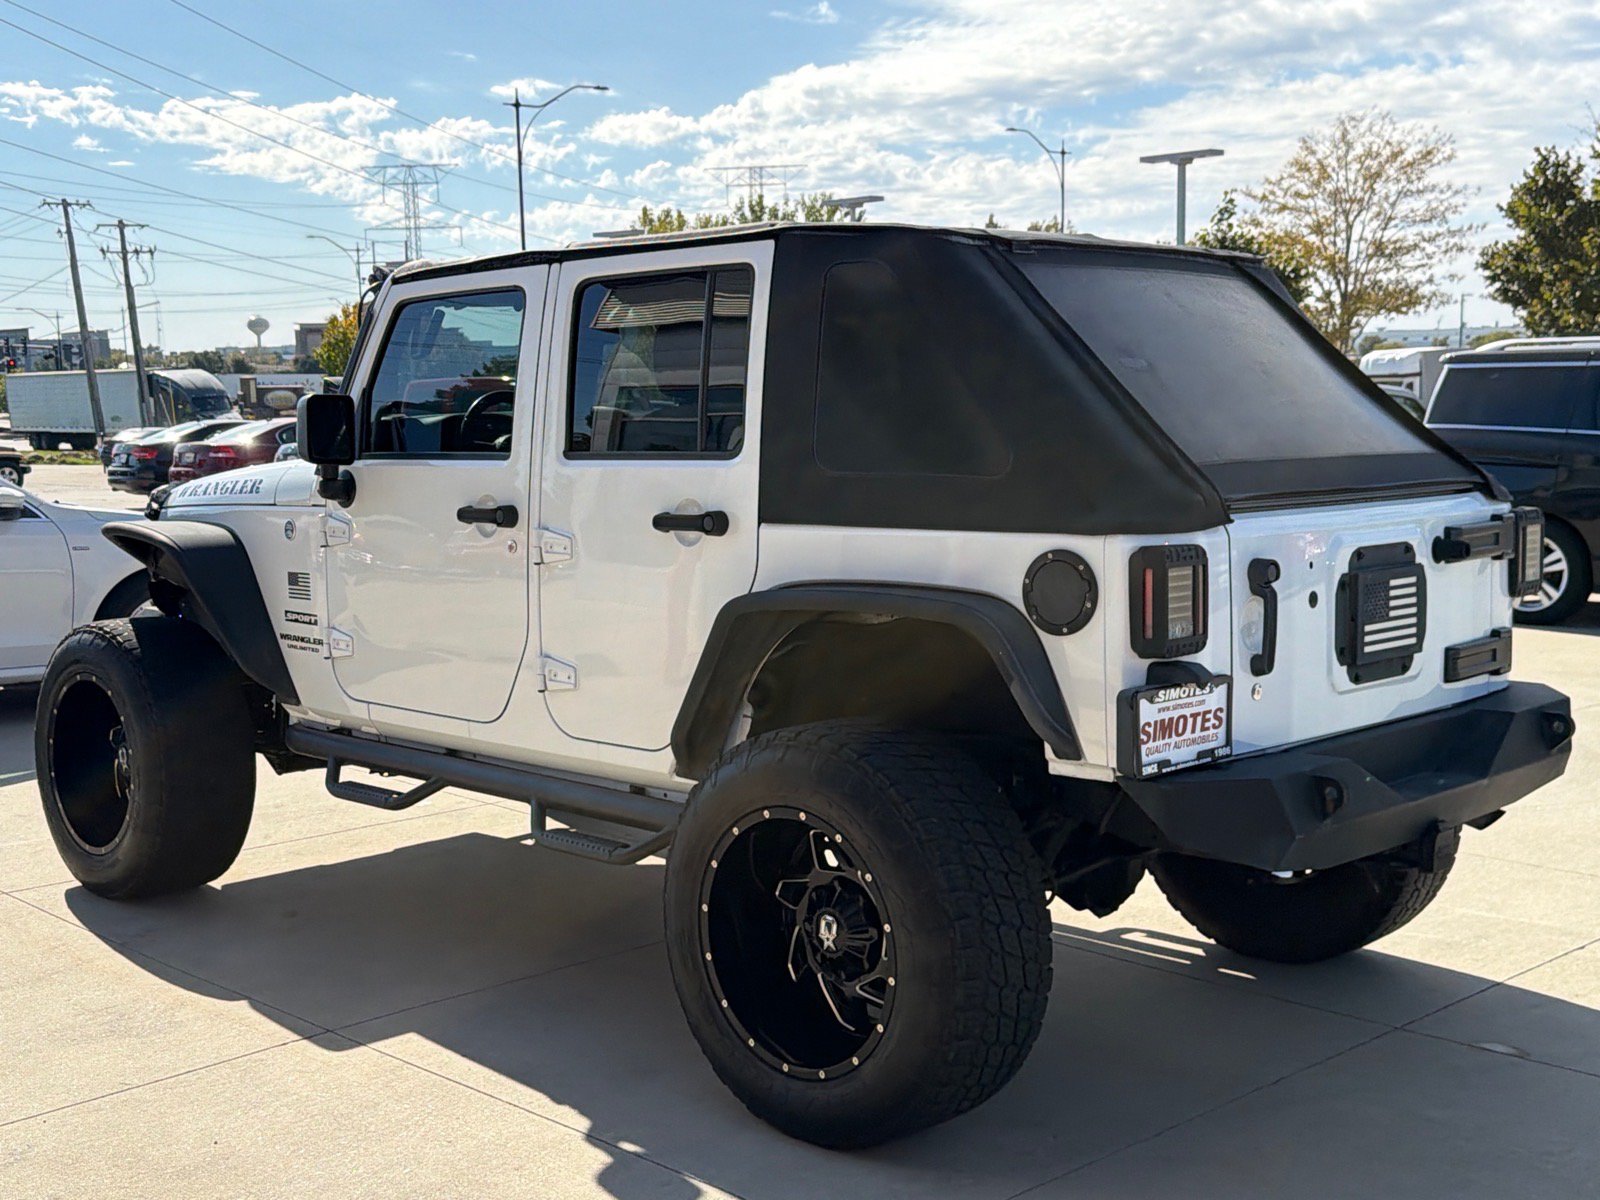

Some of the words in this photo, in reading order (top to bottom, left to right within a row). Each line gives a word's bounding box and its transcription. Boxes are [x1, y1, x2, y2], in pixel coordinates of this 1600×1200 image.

[177, 479, 263, 498] WRANGLER
[286, 611, 317, 625] SPORT
[280, 633, 324, 647] WRANGLER
[287, 643, 320, 653] UNLIMITED
[1158, 699, 1206, 713] www.simotes.com
[1139, 707, 1224, 745] SIMOTES
[1145, 742, 1172, 757] QUALITY
[1173, 732, 1219, 750] AUTOMOBILES
[1142, 763, 1158, 776] SINCE
